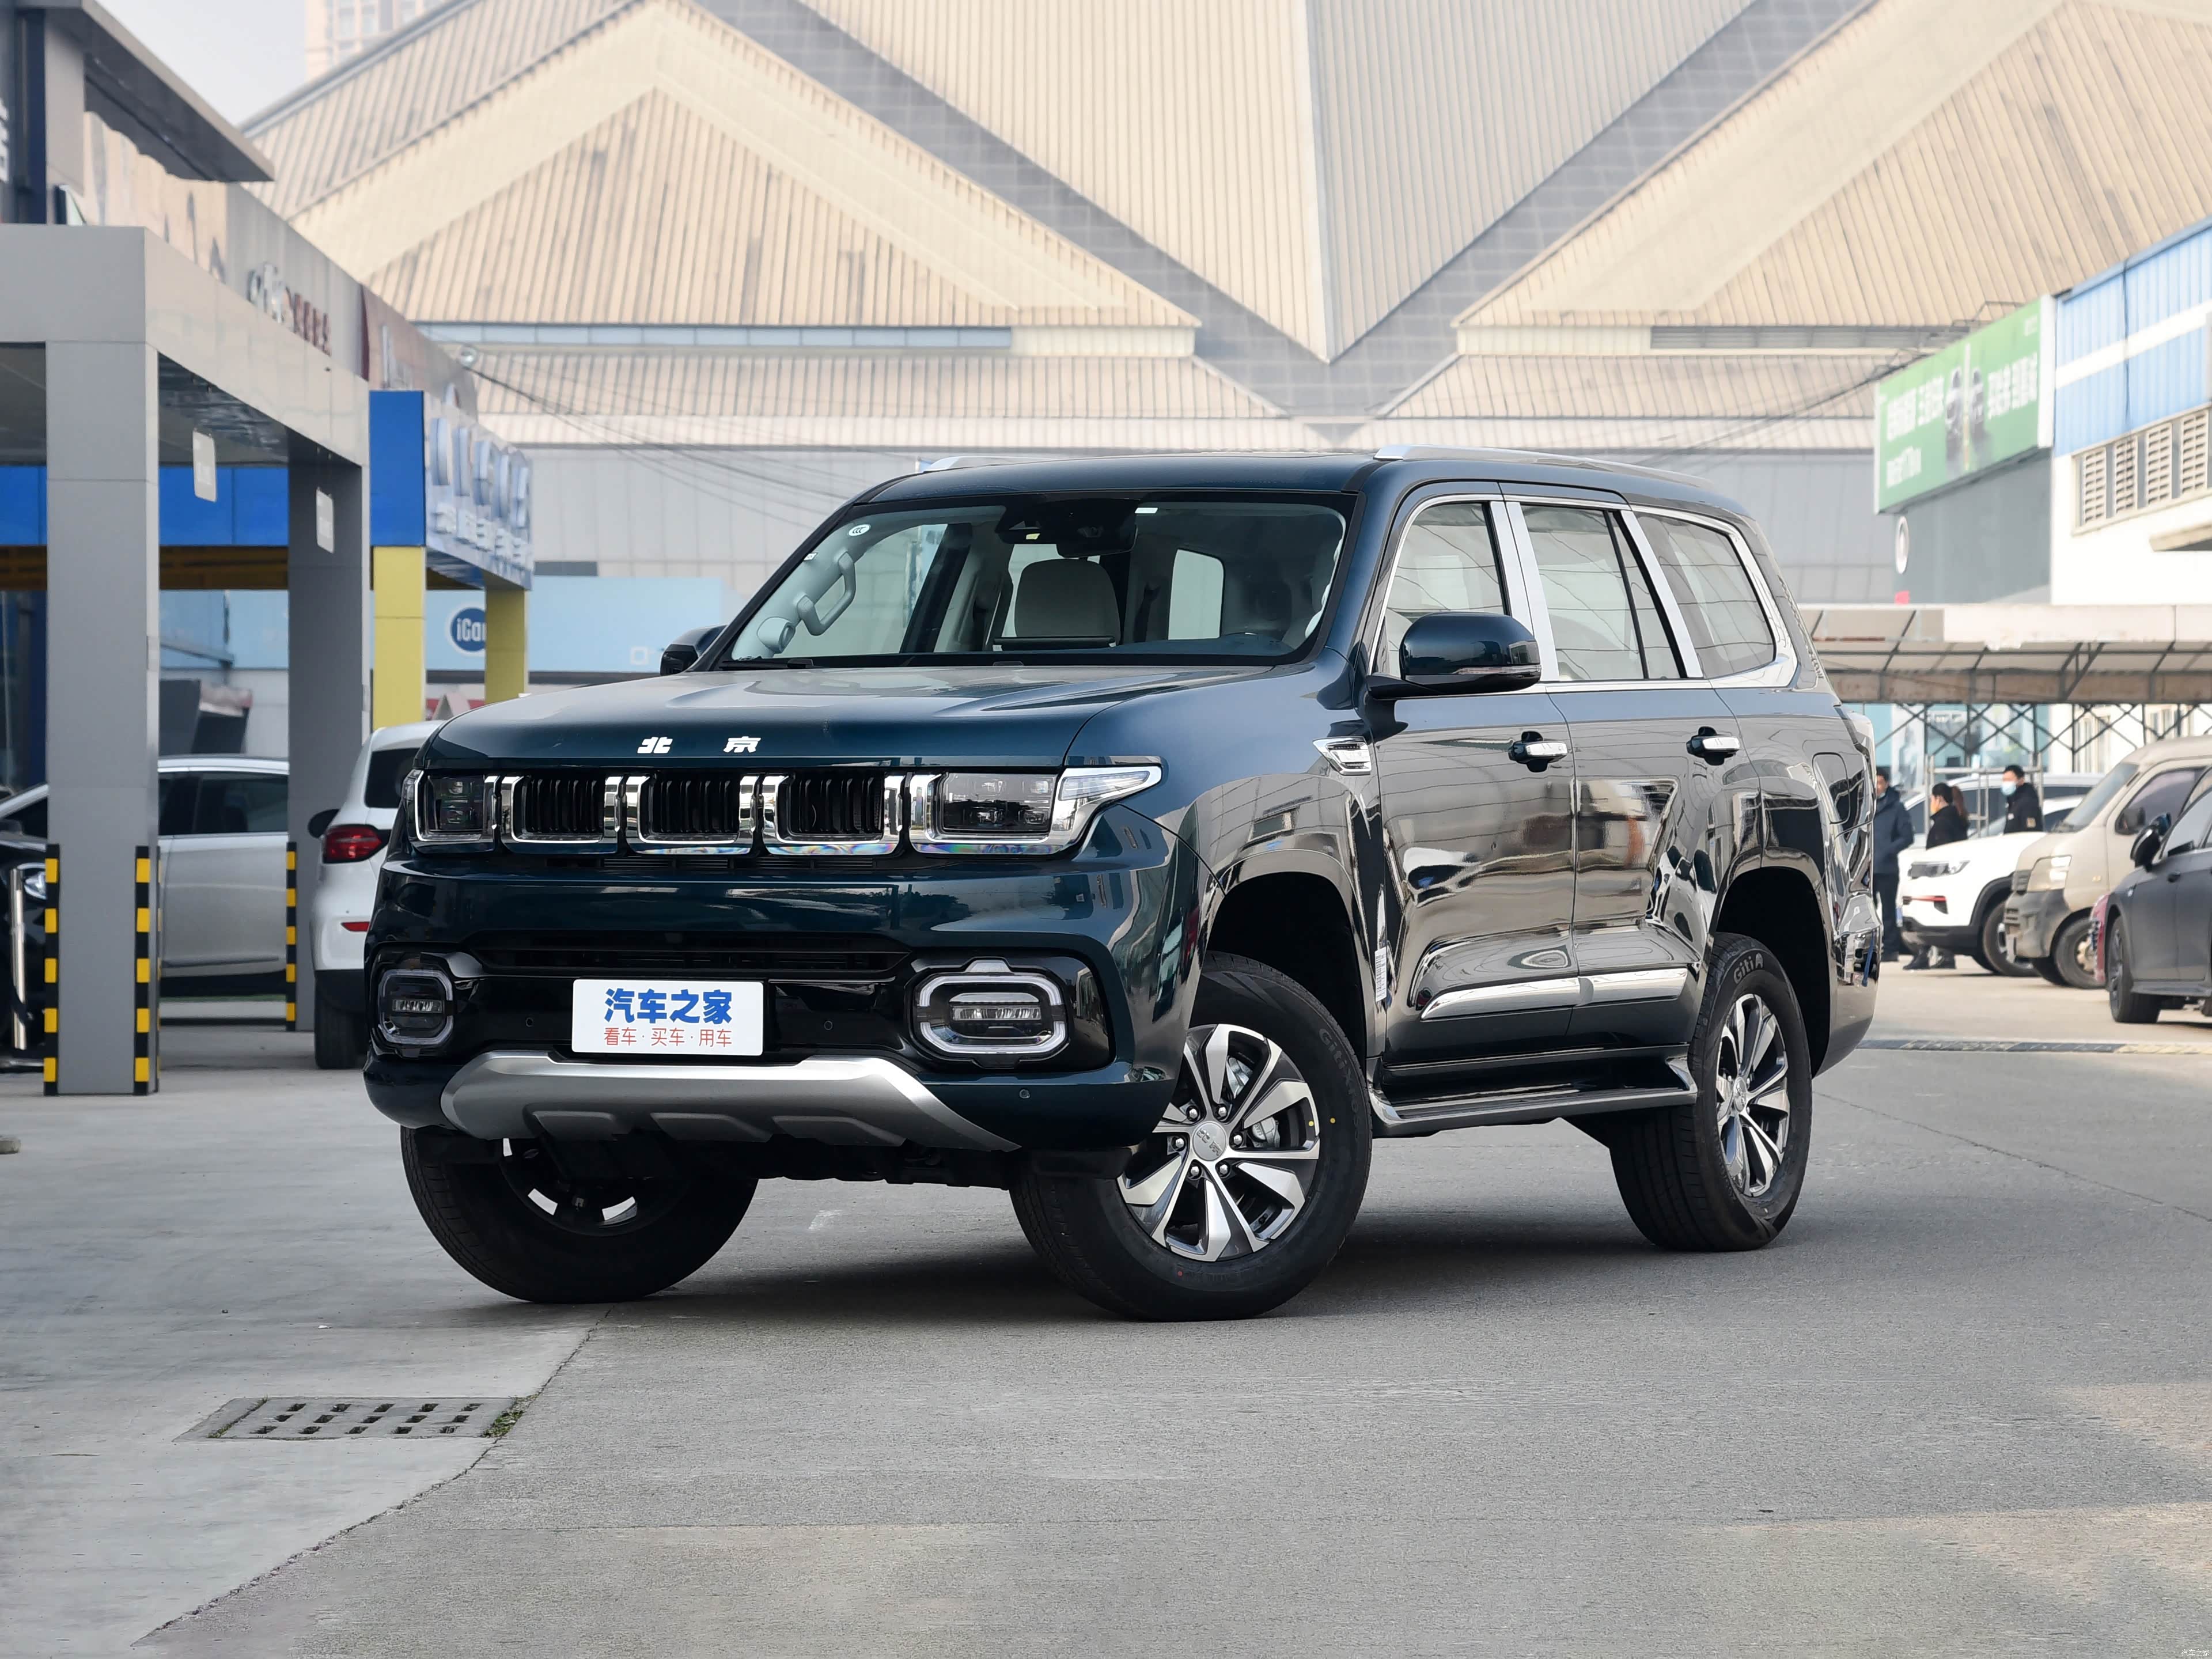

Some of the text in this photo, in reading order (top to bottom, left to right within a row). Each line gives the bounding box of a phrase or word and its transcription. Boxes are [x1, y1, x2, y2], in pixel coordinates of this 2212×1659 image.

[637, 736, 762, 753] 北京
[604, 988, 732, 1024] 汽车之家
